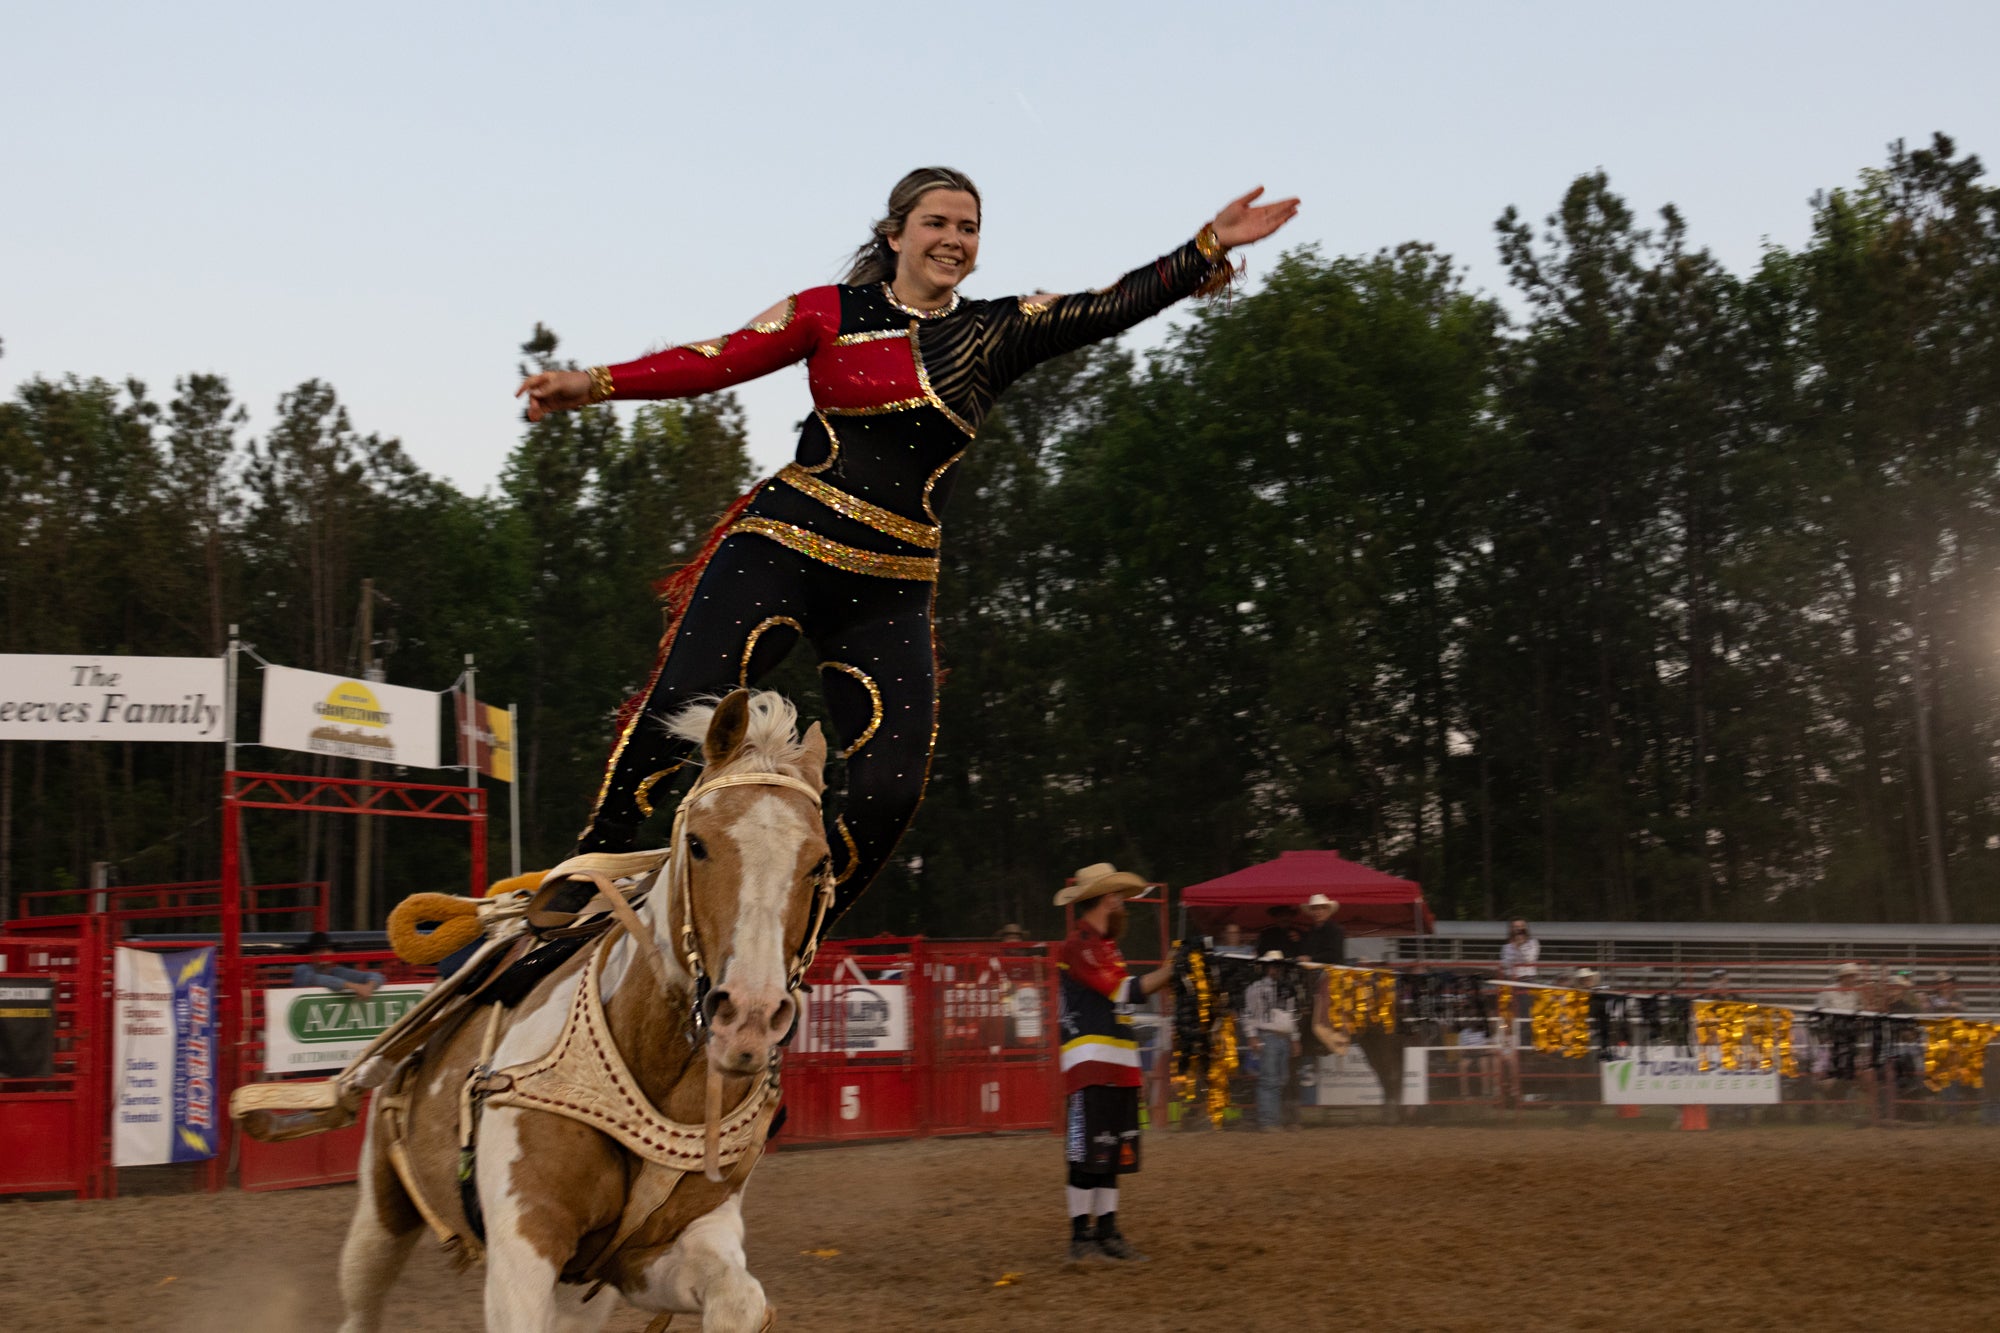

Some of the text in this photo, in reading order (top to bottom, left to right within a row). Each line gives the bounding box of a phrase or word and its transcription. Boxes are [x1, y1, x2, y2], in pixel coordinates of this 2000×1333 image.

[71, 665, 121, 687] The
[0, 693, 220, 735] eeves Family
[840, 1085, 861, 1120] 5
[981, 1081, 1000, 1113] 6
